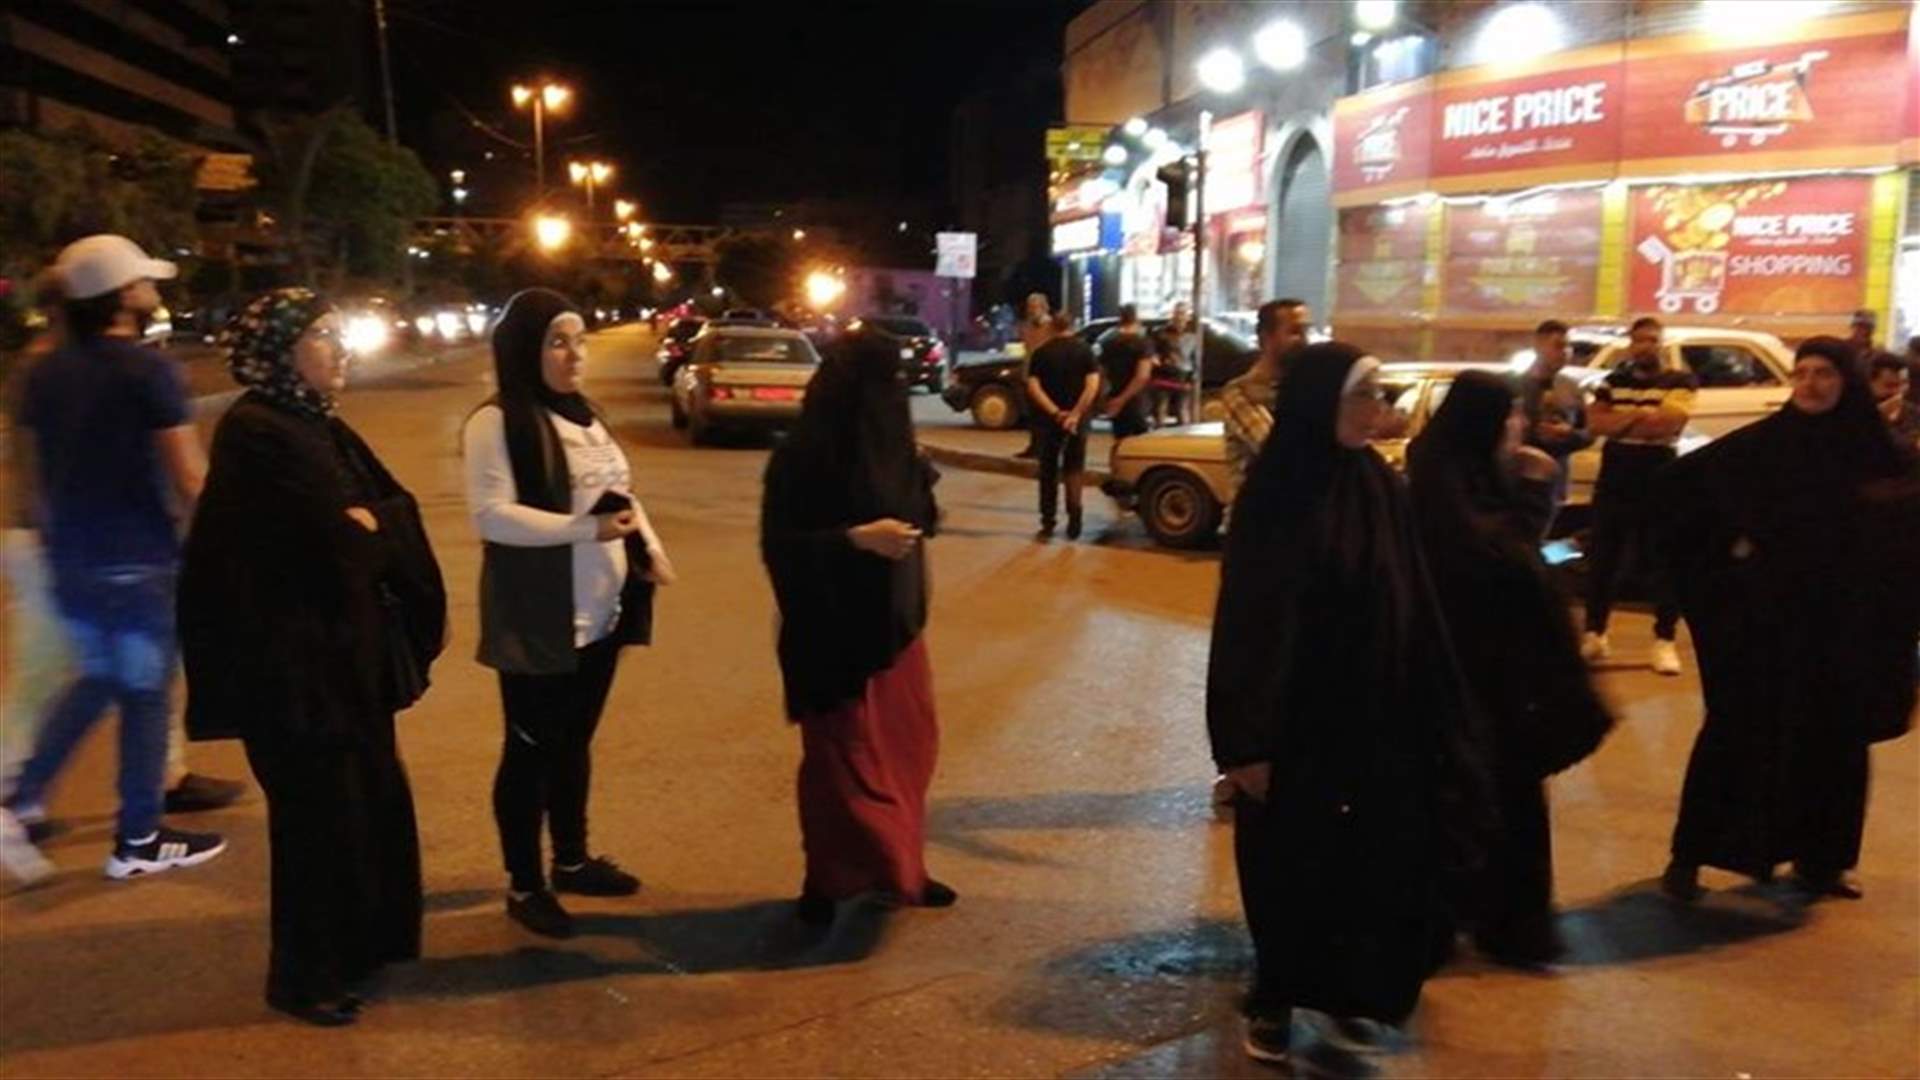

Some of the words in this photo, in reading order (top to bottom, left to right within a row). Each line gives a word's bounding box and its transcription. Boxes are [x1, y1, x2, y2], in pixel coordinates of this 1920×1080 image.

[1443, 96, 1509, 139] NICE
[1512, 81, 1606, 131] PRICE
[1709, 80, 1797, 122] PRICE
[1733, 215, 1784, 237] NICE
[1786, 212, 1855, 236] PRICE
[1729, 254, 1852, 276] SHOPPING
